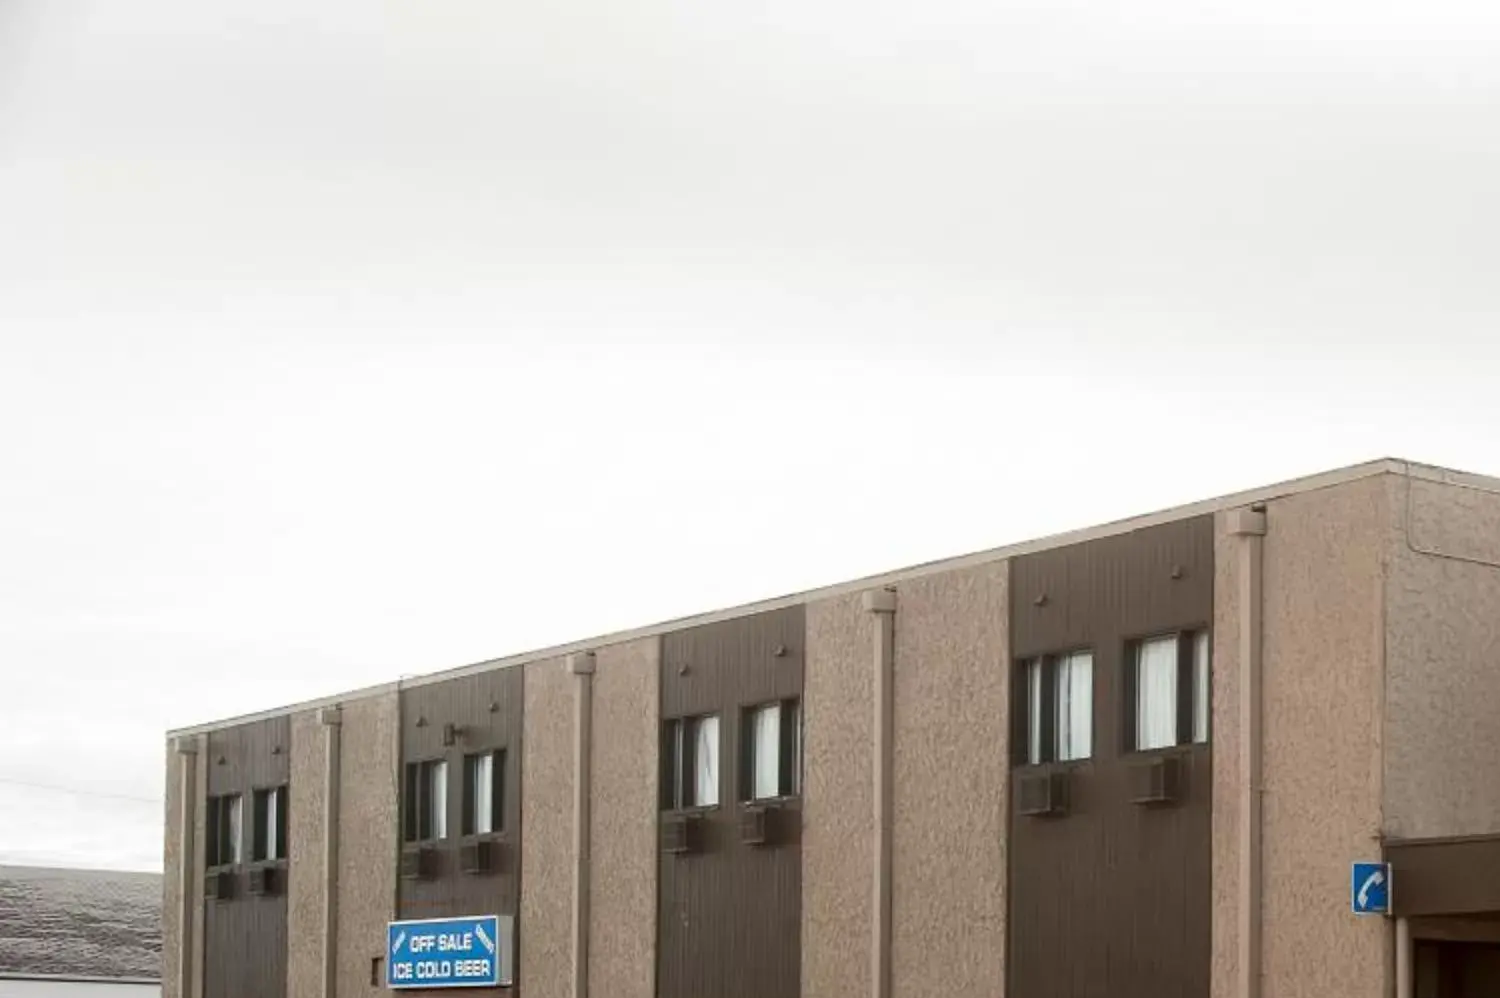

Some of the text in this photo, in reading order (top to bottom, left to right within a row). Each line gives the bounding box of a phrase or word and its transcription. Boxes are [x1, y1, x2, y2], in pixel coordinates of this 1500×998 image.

[410, 932, 473, 953] OFF SALE
[393, 959, 490, 979] ICE COLD BEER
